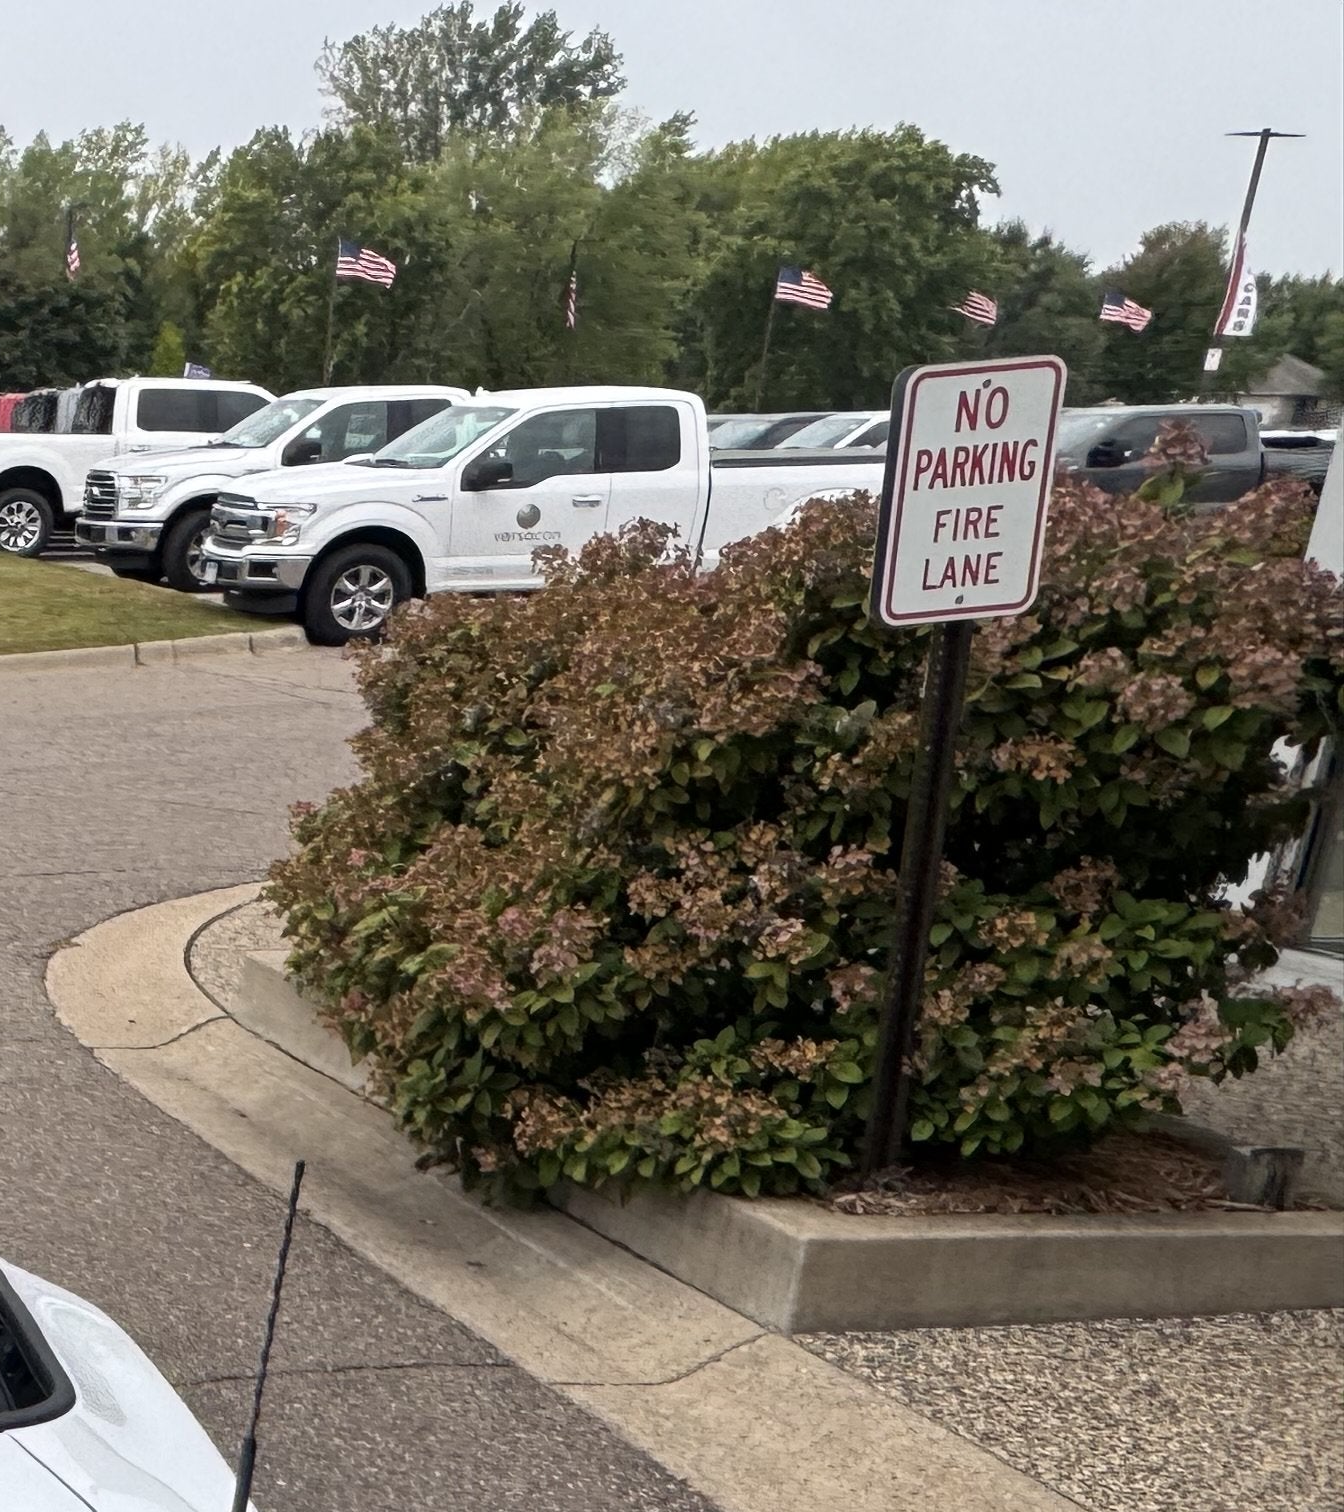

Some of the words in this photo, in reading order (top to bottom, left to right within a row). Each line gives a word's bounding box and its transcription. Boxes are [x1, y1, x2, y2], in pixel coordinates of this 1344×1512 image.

[954, 385, 1010, 433] NO
[912, 438, 1039, 491] PARKING
[932, 504, 1004, 543] FIRE
[921, 551, 1004, 591] LANE
